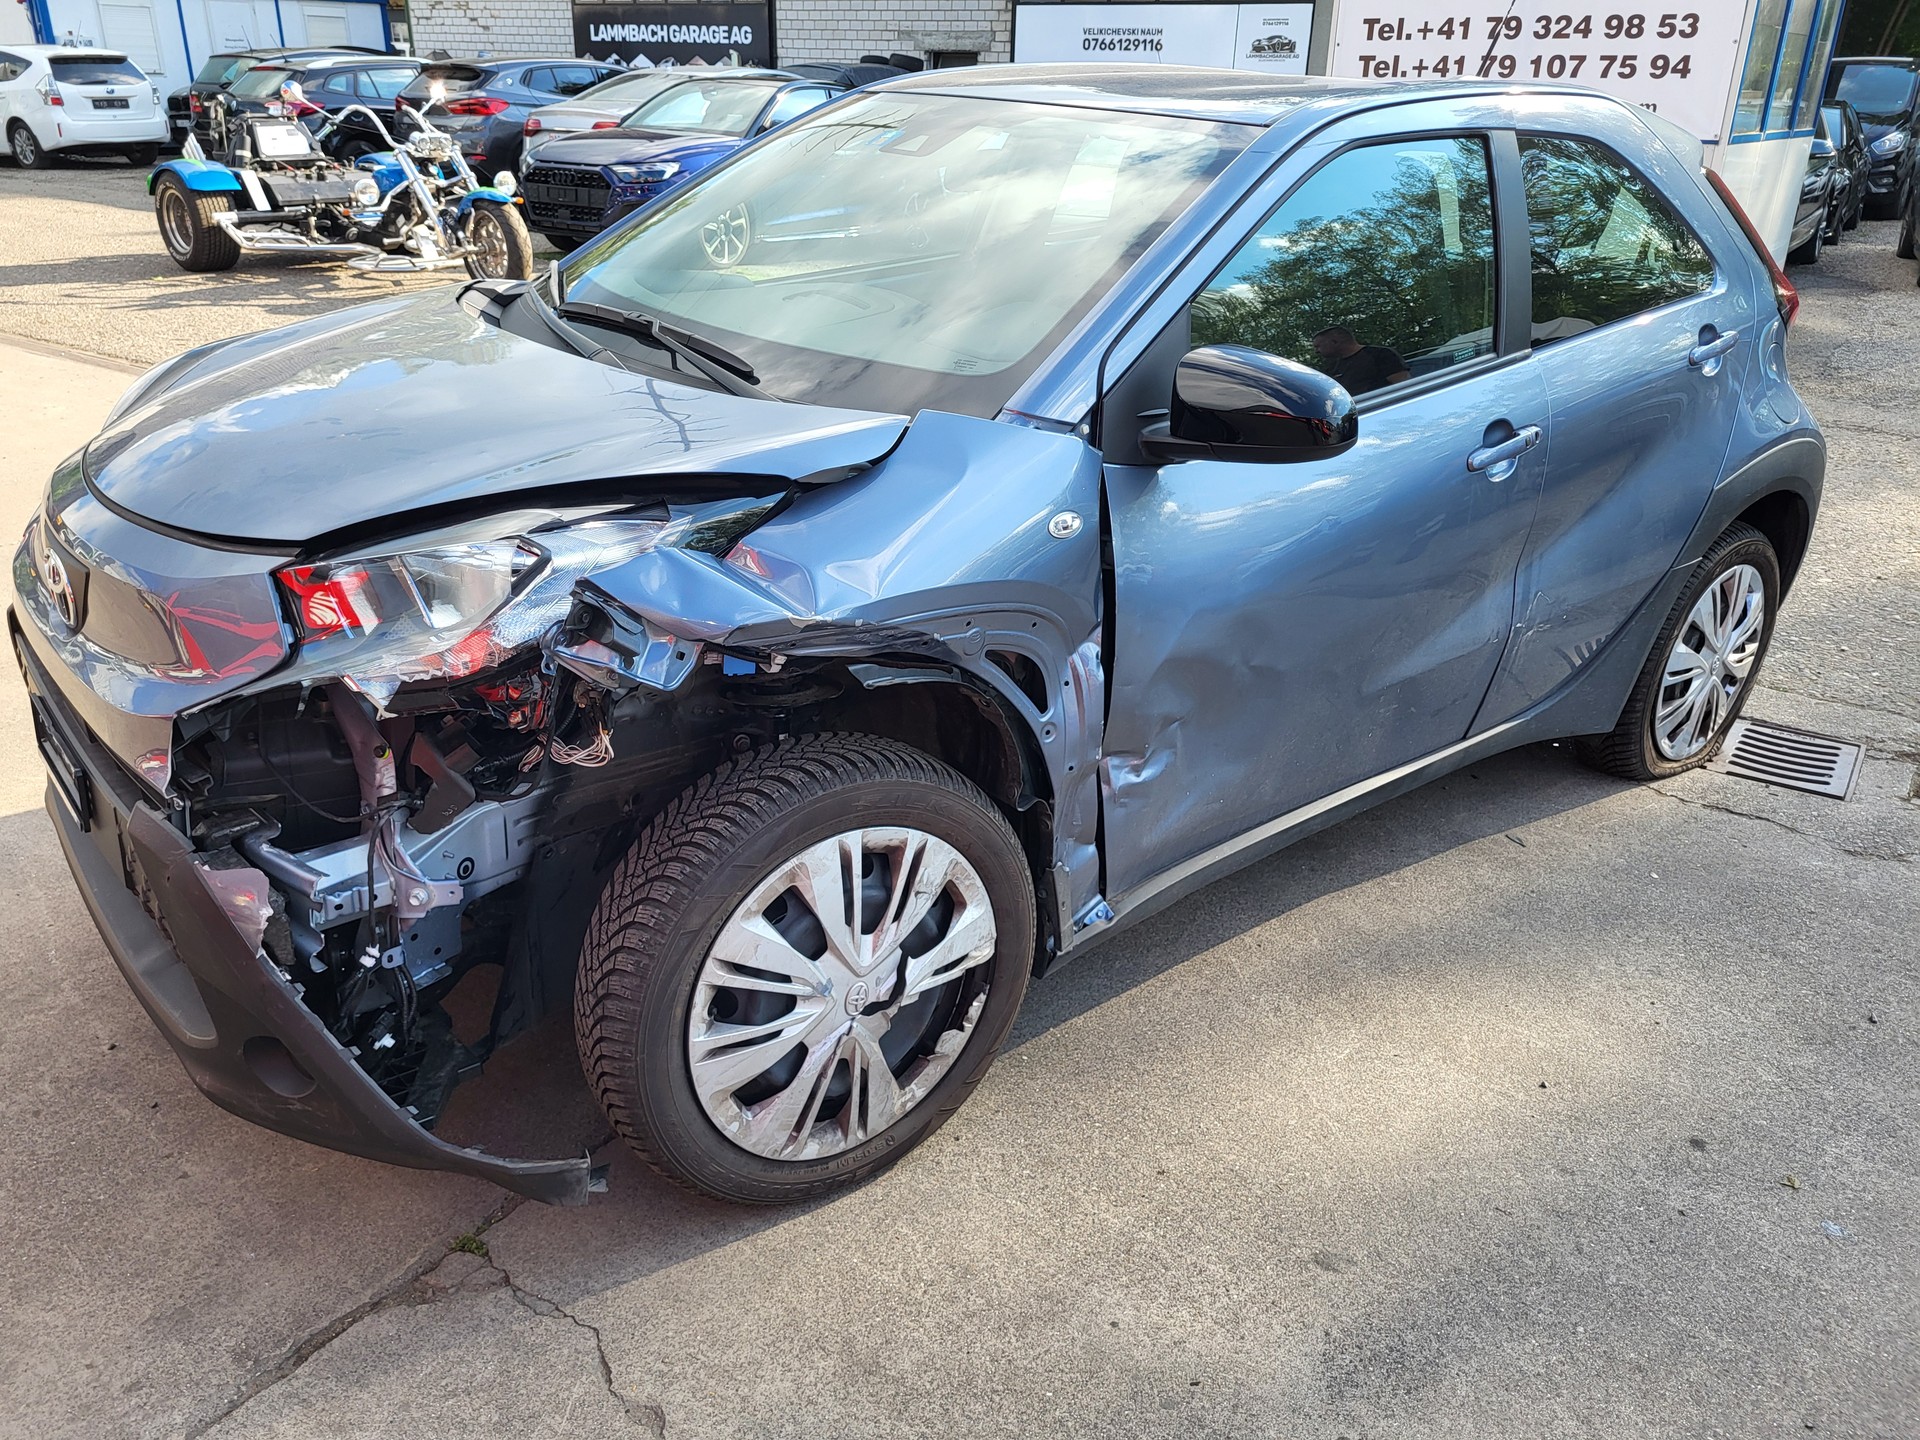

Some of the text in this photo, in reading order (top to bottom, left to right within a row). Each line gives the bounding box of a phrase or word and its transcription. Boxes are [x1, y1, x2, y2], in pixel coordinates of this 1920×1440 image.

[589, 24, 753, 45] LAMMBACH GARAGE AG
[1140, 28, 1163, 36] NAUM
[1487, 15, 1522, 40] 79
[1533, 14, 1593, 40] 324
[1604, 13, 1646, 40] 98
[1656, 12, 1700, 40] 53
[1082, 37, 1164, 52] 0766129116
[1481, 54, 1517, 79] 79
[1530, 54, 1588, 79] 107
[1599, 54, 1638, 79] 75
[1649, 54, 1692, 79] 94
